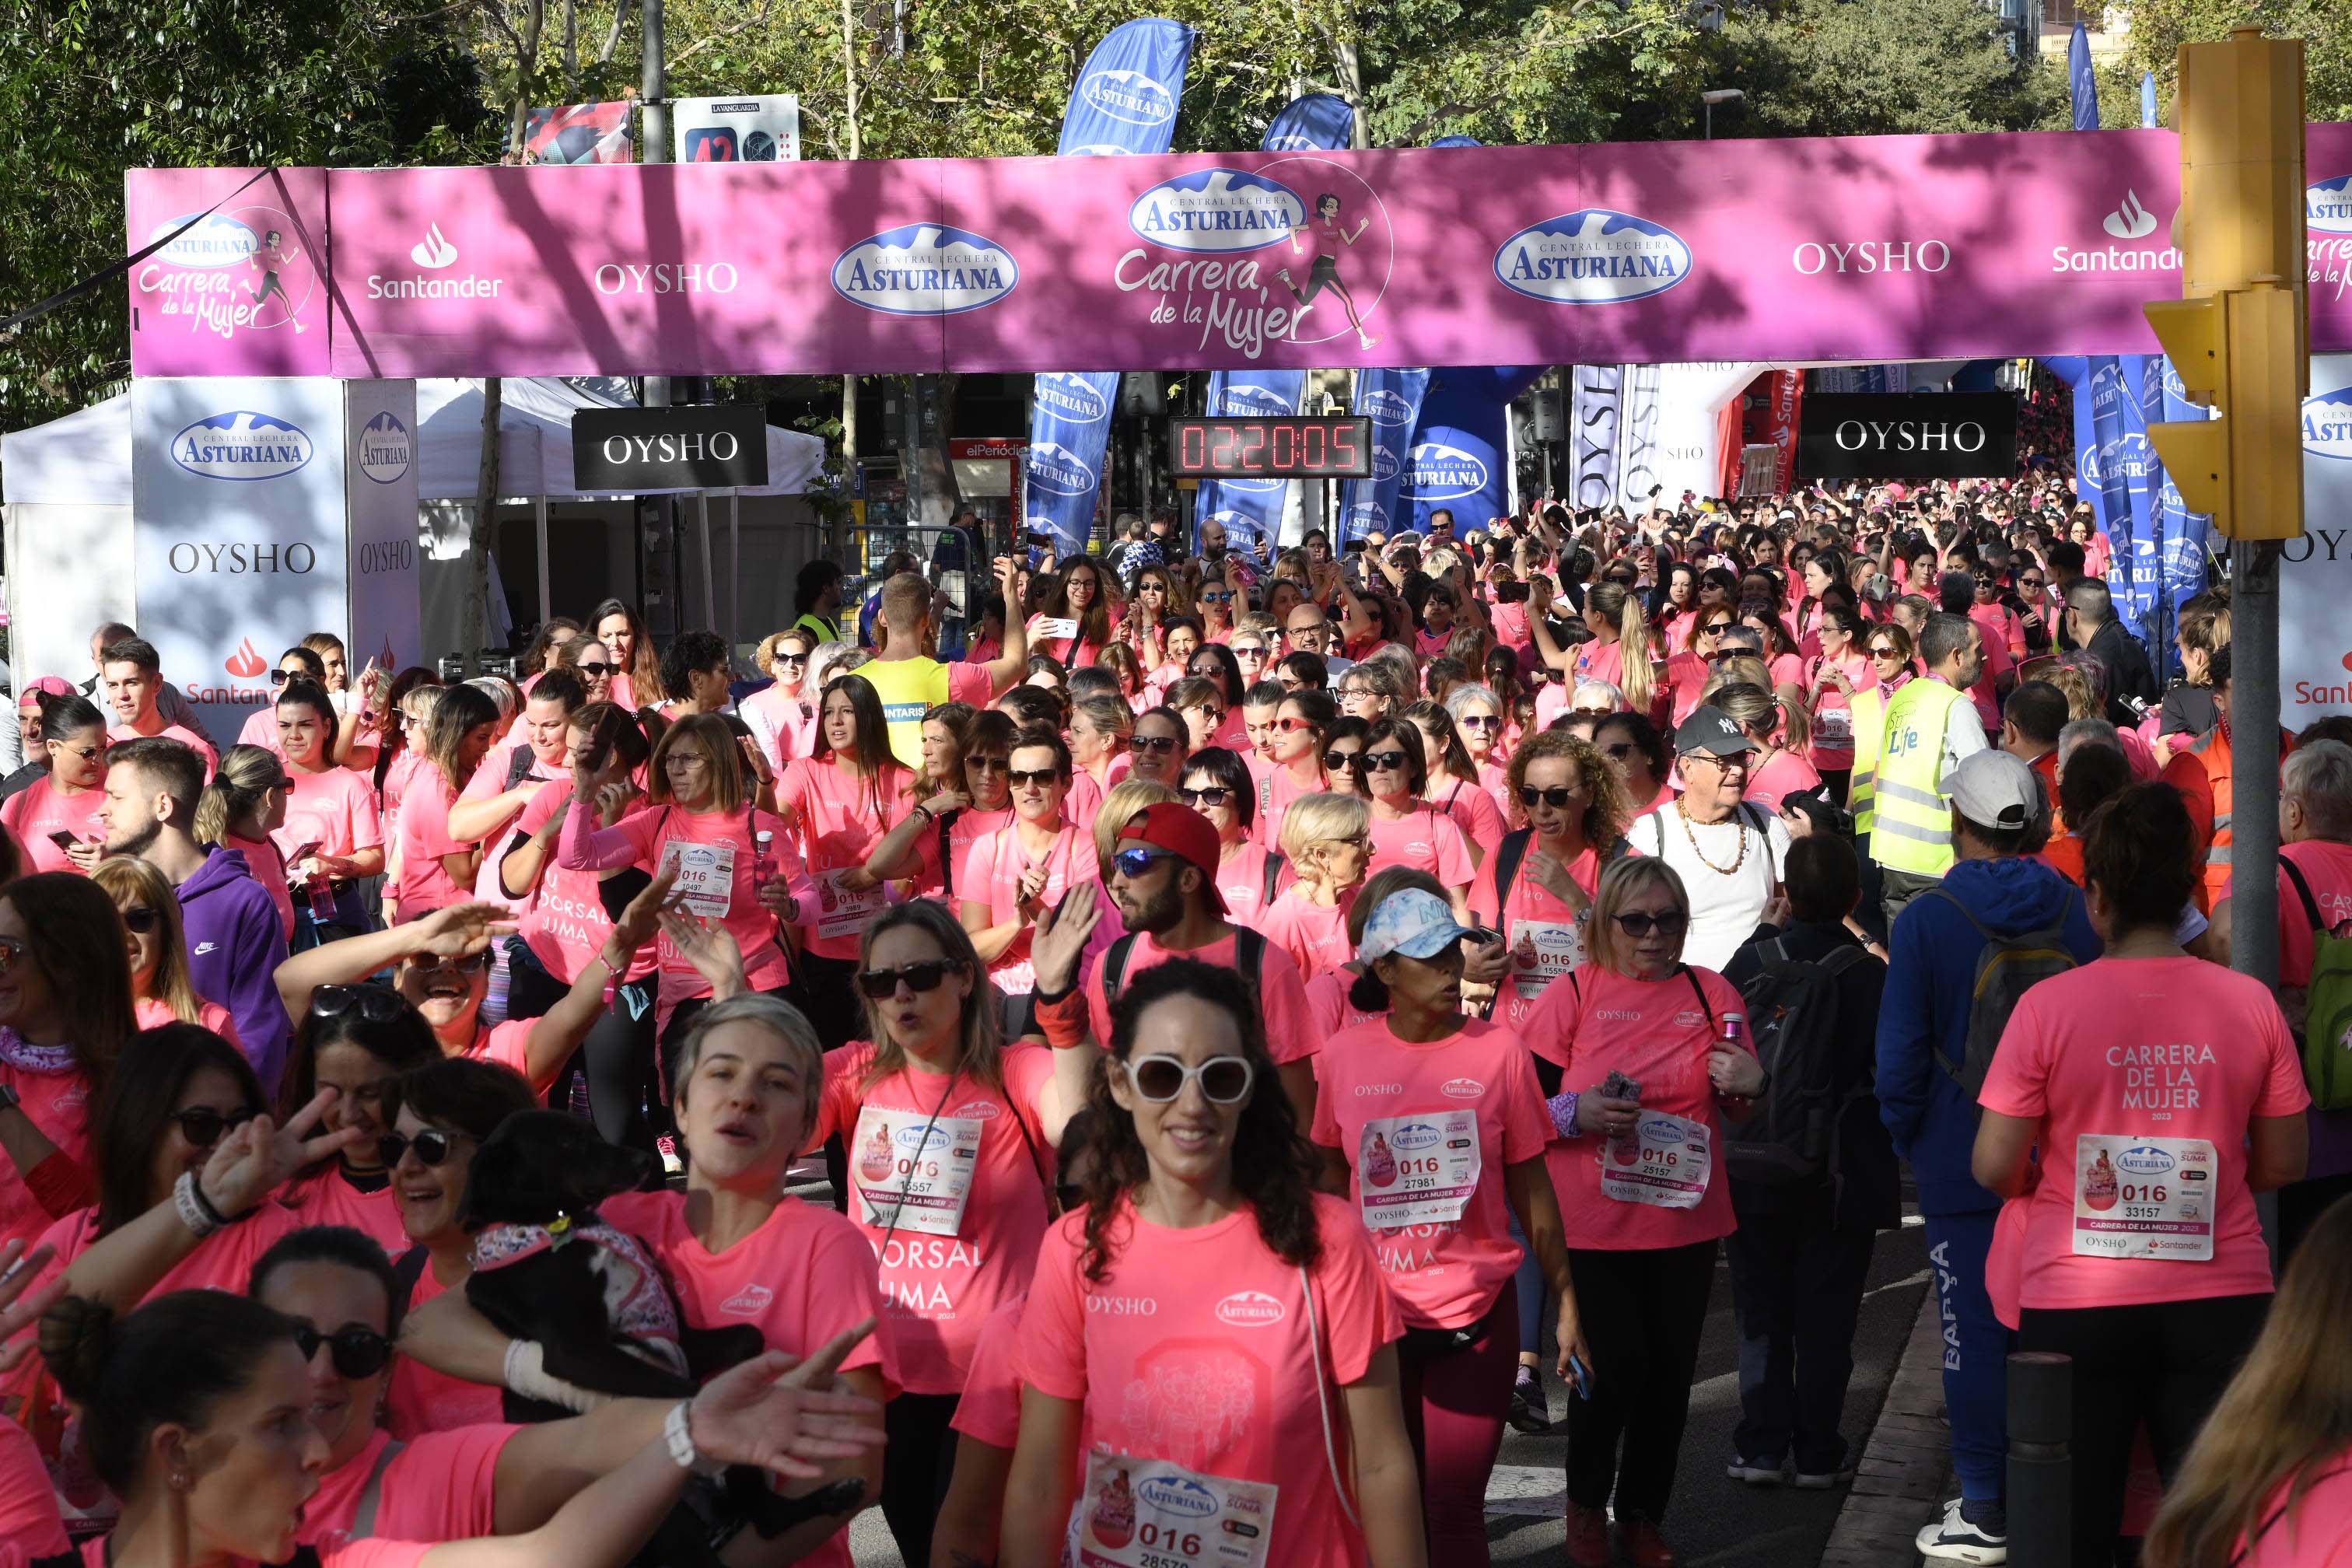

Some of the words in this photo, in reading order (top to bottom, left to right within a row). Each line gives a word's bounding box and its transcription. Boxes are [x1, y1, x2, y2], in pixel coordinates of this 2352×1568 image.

[1170, 198, 1225, 206] CENTRAL
[1231, 197, 1288, 205] LECHERA
[1143, 201, 1292, 232] ASTURIANA
[1540, 243, 1602, 251] CENTRAL
[1606, 241, 1671, 250] LECHERA
[874, 255, 933, 264] CENTRAL
[940, 254, 998, 264] LECHERA
[1509, 246, 1677, 280] ASTURIANA
[1792, 240, 1951, 274] OYSHO
[846, 257, 1004, 292] ASTURIANA
[1114, 248, 1260, 292] Carrera
[2325, 261, 2339, 282] la
[138, 264, 231, 292] Carrera
[594, 262, 738, 294] OYSHO
[367, 274, 503, 299] Santander
[161, 294, 180, 314] de
[180, 295, 194, 315] la
[193, 289, 266, 338] Mujer
[1150, 294, 1177, 324] de
[1183, 292, 1203, 324] la
[1198, 286, 1314, 359] Mujer
[1835, 420, 1986, 452] OYSHO
[182, 436, 303, 463] ASTURIANA
[362, 439, 408, 466] ASTURIANA
[603, 431, 739, 465] OYSHO
[1182, 425, 1356, 468] 02:20:05
[2280, 530, 2352, 562] OY
[169, 542, 316, 574] OYSHO
[360, 539, 412, 574] OYSHO
[685, 855, 712, 863] ASTURIANA
[682, 870, 707, 882] 016
[683, 883, 702, 891] 10497
[838, 894, 864, 904] 016
[1538, 935, 1571, 944] ASTURIANA
[1540, 953, 1570, 965] 016
[1597, 1010, 1641, 1021] OYSHO
[2105, 1045, 2216, 1066] CARRERA
[2128, 1067, 2156, 1087] DE
[2166, 1066, 2195, 1087] LA
[1355, 1083, 1404, 1096] OYSHO
[1445, 1085, 1482, 1095] ASTURIANA
[2123, 1088, 2200, 1109] MUJER
[2152, 1112, 2172, 1121] 2023
[1445, 1125, 1468, 1133] SUMA
[1644, 1126, 1682, 1140] ASTURIANA
[1395, 1133, 1437, 1146] ASTURIANA
[1643, 1148, 1677, 1165] 016
[2121, 1157, 2171, 1169] ASTURIANA
[2181, 1154, 2207, 1163] SUMA
[898, 1158, 939, 1178] 016
[1401, 1157, 1439, 1175] 016
[1643, 1166, 1671, 1177] 25157
[900, 1181, 933, 1193] 15557
[1405, 1178, 1436, 1189] 27981
[1615, 1174, 1642, 1182] CARRERA
[1661, 1180, 1682, 1189] MUJER
[865, 1192, 899, 1201] CARRERA
[923, 1199, 947, 1207] MUJER
[1376, 1195, 1408, 1204] CARRERA
[1610, 1185, 1640, 1196] OYSHO
[1664, 1193, 1695, 1202] Santander
[2122, 1184, 2167, 1202] 016
[1374, 1209, 1410, 1220] OYSHO
[2125, 1206, 2160, 1218] 33157
[2090, 1221, 2128, 1230] CARRERA
[2085, 1237, 2127, 1248] OYSHO
[2160, 1240, 2202, 1250] Santander
[1427, 1268, 1444, 1276] 2023
[1085, 1295, 1157, 1316] OYSHO
[1222, 1304, 1280, 1318] ASTURIANA
[1144, 1485, 1212, 1514] ASTURIANA
[1227, 1500, 1262, 1514] SUMA
[1139, 1523, 1201, 1556] 016
